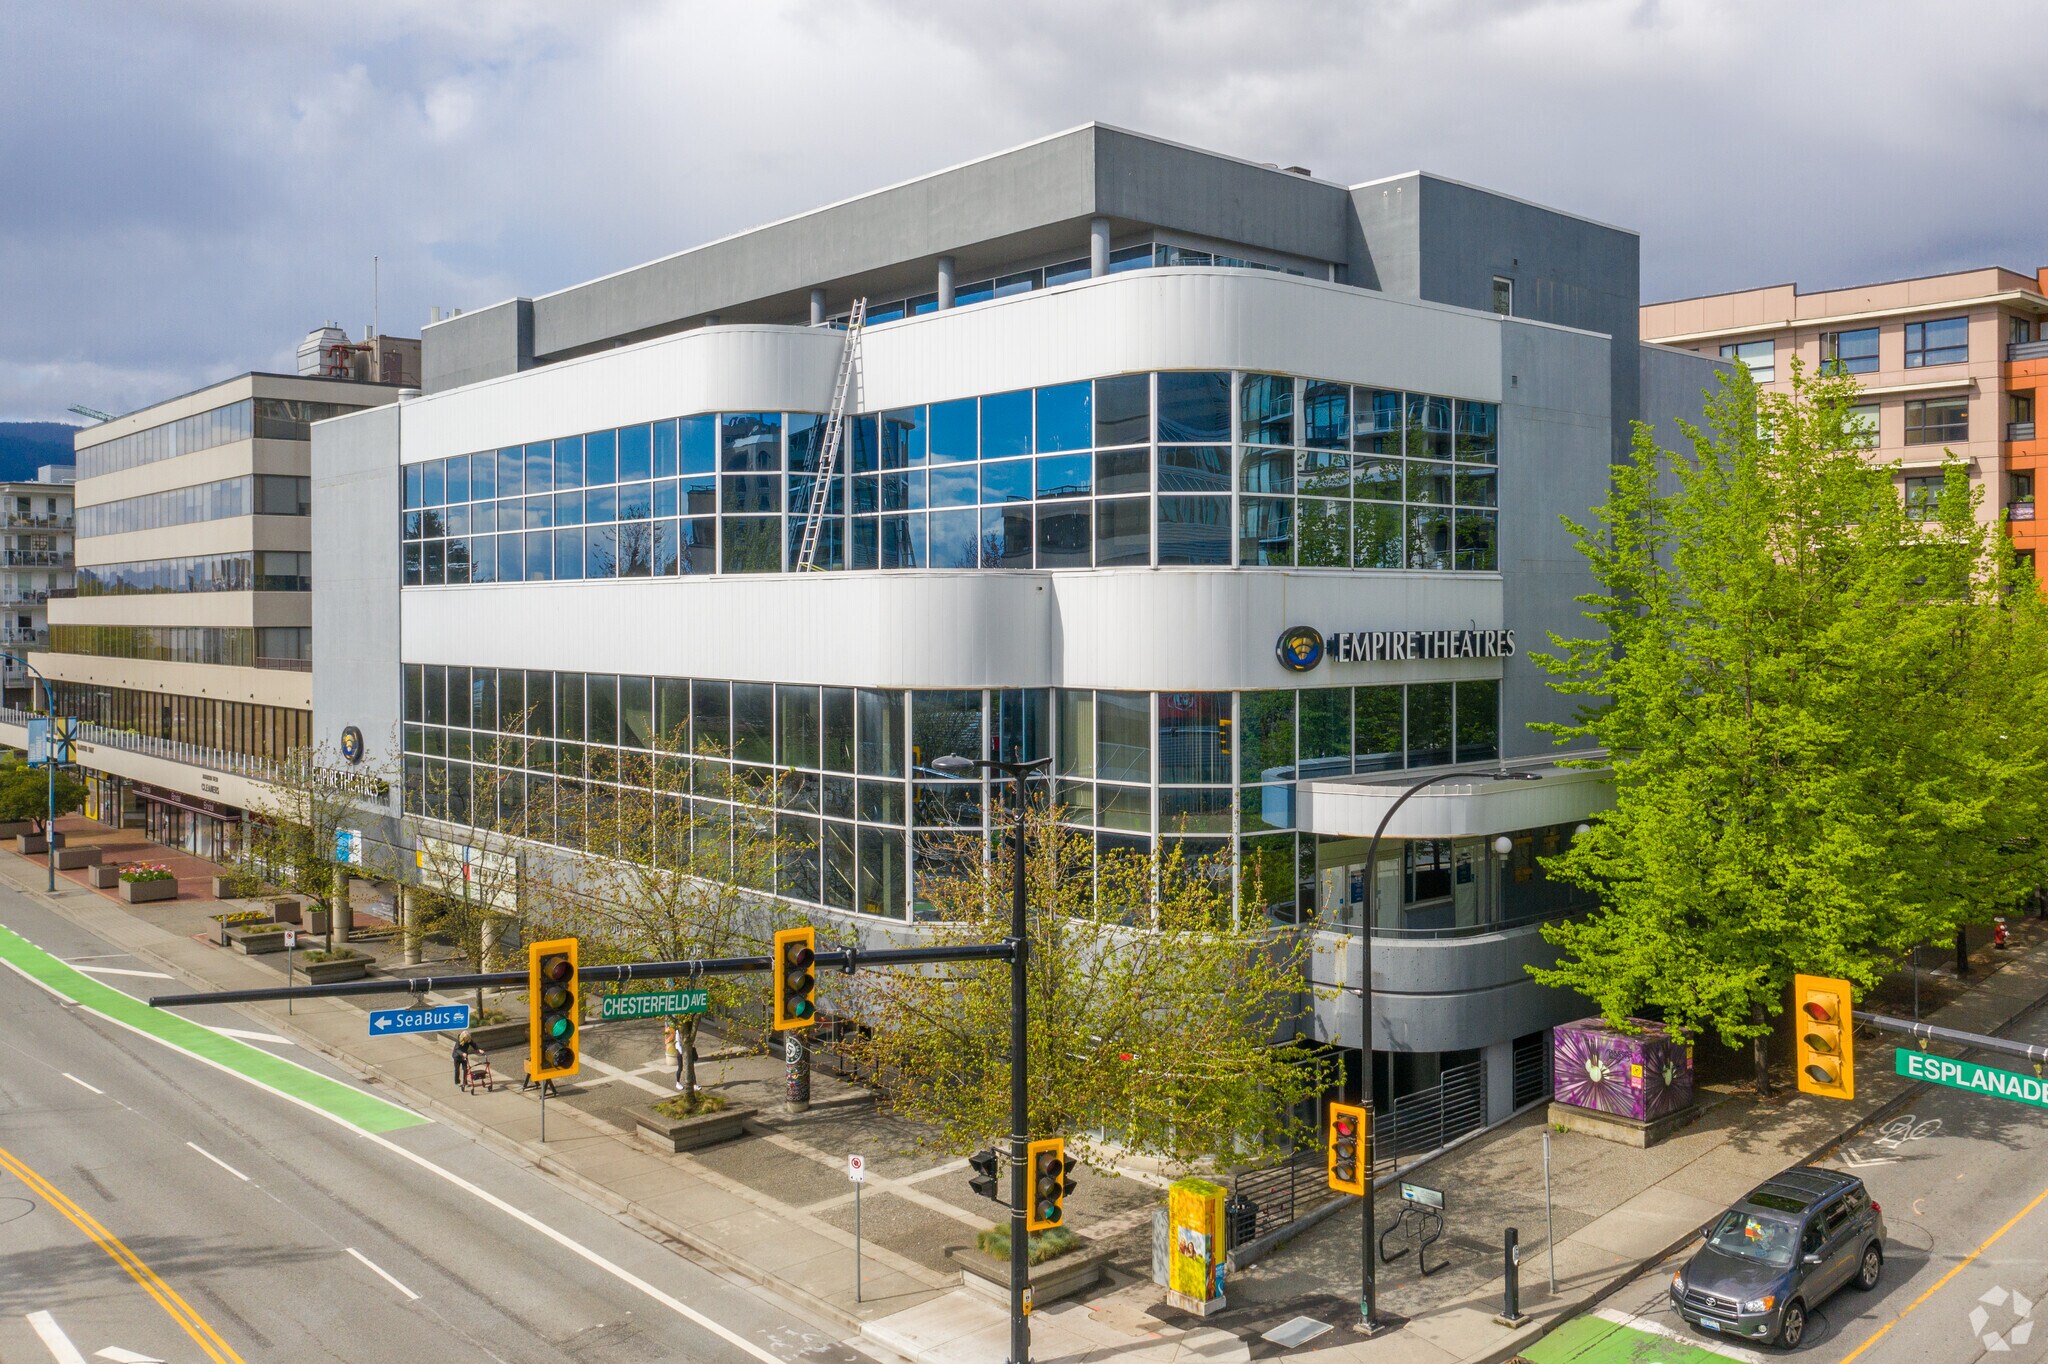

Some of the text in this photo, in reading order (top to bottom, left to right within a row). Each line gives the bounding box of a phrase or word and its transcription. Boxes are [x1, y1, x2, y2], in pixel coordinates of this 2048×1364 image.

[1337, 629, 1516, 663] EMPIRE THEATRES
[311, 766, 338, 788] EMPIRE
[603, 993, 707, 1016] CHESTERFIELD AVE
[396, 1011, 450, 1028] SeaBus
